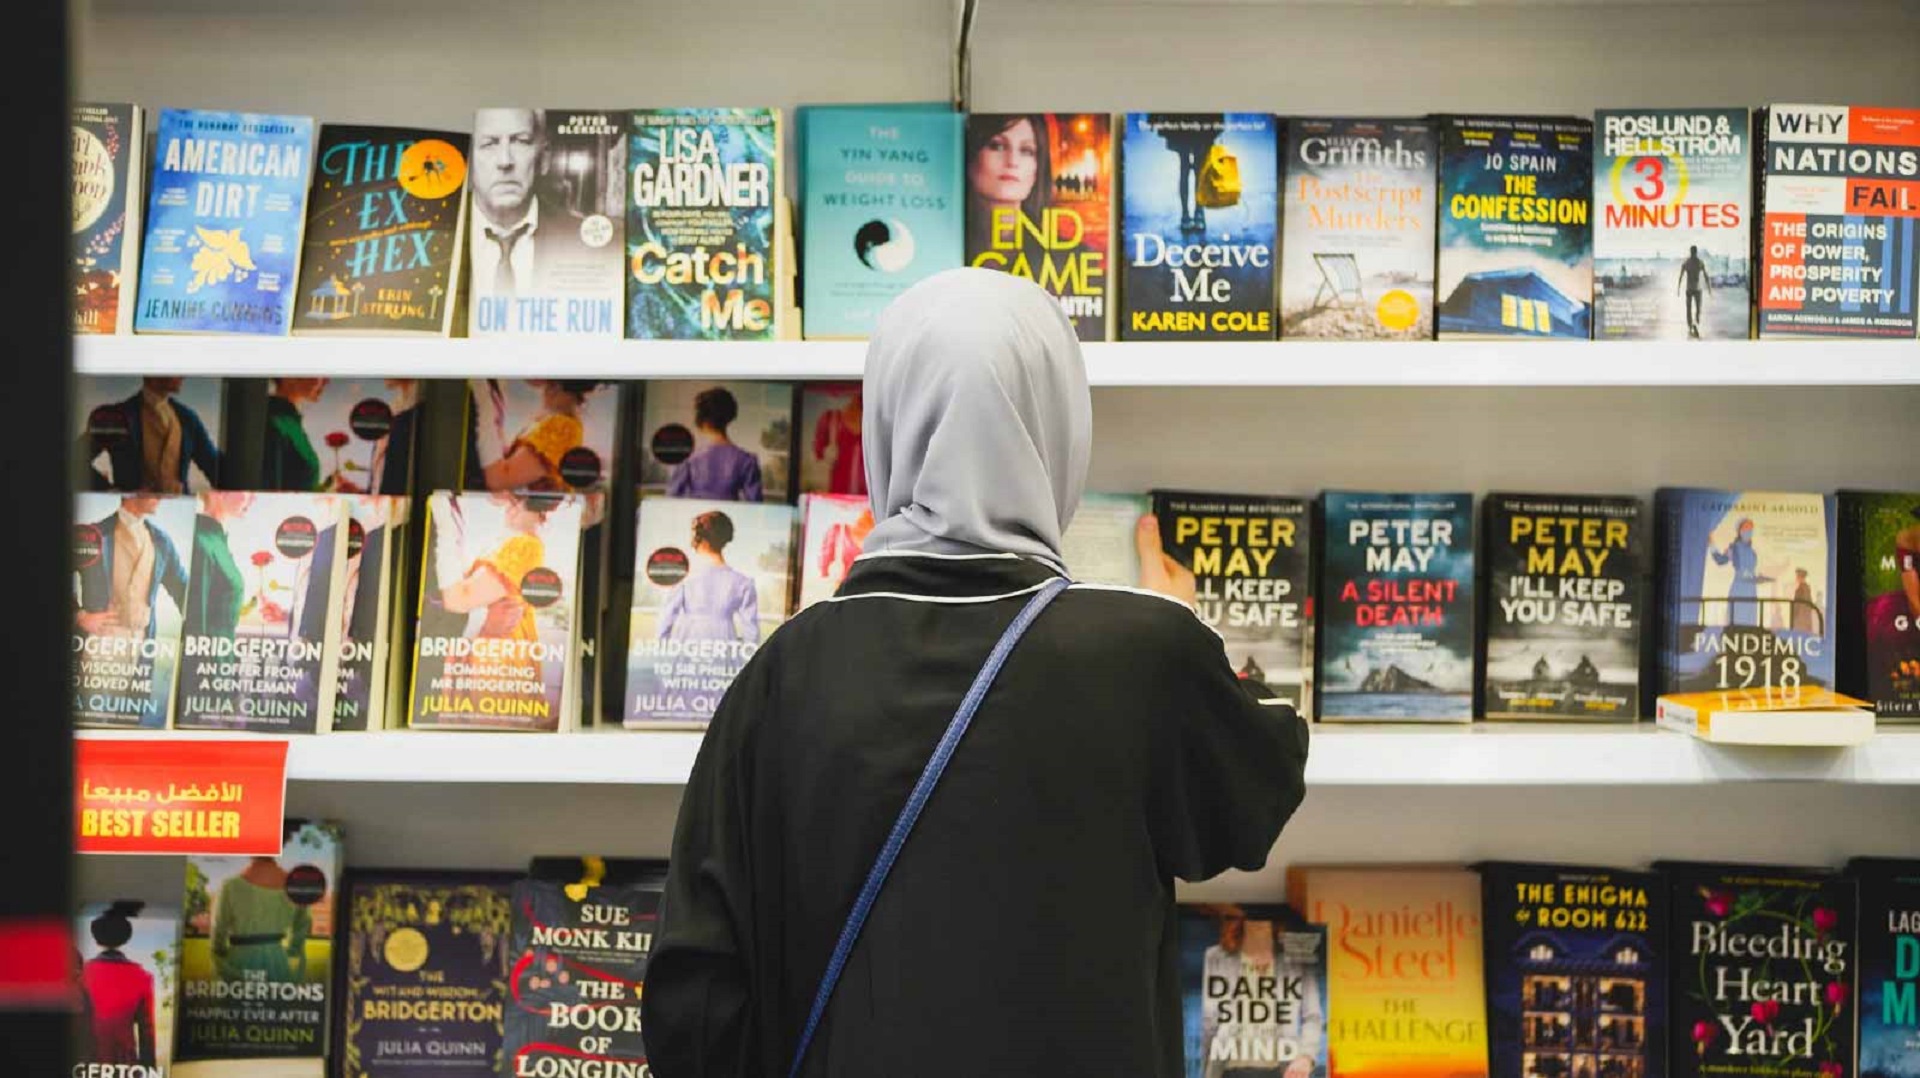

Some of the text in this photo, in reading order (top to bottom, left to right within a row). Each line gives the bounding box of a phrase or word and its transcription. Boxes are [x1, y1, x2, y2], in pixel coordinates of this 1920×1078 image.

[569, 115, 607, 126] PETER
[1604, 115, 1731, 136] ROSLUND &
[1776, 113, 1843, 134] WHY
[869, 126, 900, 140] THE
[660, 128, 720, 164] LISA
[840, 149, 930, 163] YIN YANG
[1300, 137, 1426, 168] Griffiths
[1604, 134, 1741, 157] HELLSTRÖM
[163, 137, 301, 178] AMERICAN
[1484, 153, 1556, 173] JO SPAIN
[1774, 148, 1918, 176] NATIONS
[634, 162, 769, 207] GARDNER
[845, 171, 925, 186] GUIDE TO
[1504, 174, 1537, 195] THE
[1633, 156, 1664, 202] 3
[194, 181, 262, 218] DIRT
[823, 193, 947, 210] WEIGHT LOSS
[1298, 174, 1422, 211] Postscript
[1853, 186, 1916, 211] FAIL
[357, 189, 410, 230] EX
[1309, 204, 1421, 230] Murders
[1451, 193, 1587, 224] CONFESSION
[1605, 203, 1741, 229] MINUTES
[992, 208, 1084, 250] END
[1772, 222, 1887, 240] THE ORIGINS
[346, 230, 435, 278] HEX
[1132, 232, 1269, 268] Deceive
[1770, 243, 1870, 263] OF POWER,
[631, 243, 764, 285] Catch
[1769, 265, 1883, 283] PROSPERITY
[378, 288, 413, 302] ERIN
[1170, 268, 1231, 303] Me
[1768, 286, 1895, 305] AND POVERTY
[361, 302, 426, 320] STERLING
[478, 296, 612, 333] ON THE RUN
[701, 289, 771, 332] Me
[1132, 311, 1270, 331] KAREN COLE
[1176, 517, 1296, 547] PETER
[1349, 519, 1453, 546] PETER
[1511, 516, 1629, 548] PETER
[1193, 547, 1276, 577] MAY
[1366, 547, 1435, 572] MAY
[1528, 546, 1609, 577] MAY
[1225, 578, 1291, 600] KEEP
[1341, 580, 1458, 602] A SILENT
[1510, 576, 1625, 602] I'LL KEEP
[1228, 602, 1298, 627] SAFE
[1356, 604, 1442, 627] DEATH
[1500, 598, 1632, 628] YOU SAFE
[184, 636, 322, 662] BRIDGERTON
[420, 637, 564, 662] BRIDGERTON
[1694, 632, 1824, 657] PANDEMIC
[80, 661, 152, 676] VISCOUNT
[196, 663, 303, 681] AN OFFER FROM
[444, 663, 536, 679] ROMANCING
[654, 663, 696, 676] TO SIR
[1716, 655, 1801, 688] 1918
[83, 677, 153, 693] LOVED ME
[199, 679, 297, 694] A GENTLEMAN
[430, 678, 546, 694] MR BRIDGERTON
[662, 678, 698, 690] WITH
[89, 694, 158, 715] QUINN
[184, 696, 308, 718] JULIA QUINN
[420, 695, 474, 717] JULIA
[479, 697, 549, 718] QUINN
[634, 694, 686, 714] JULIA
[156, 781, 243, 804] الأفضل
[82, 809, 240, 838] BEST SELLER
[1516, 883, 1649, 908] THE ENIGMA
[581, 904, 630, 925] SUE
[1314, 901, 1480, 939] Danielle
[1537, 907, 1649, 931] ROOM 622
[532, 926, 610, 949] MONK
[1691, 920, 1848, 975] Bleeding
[1338, 935, 1457, 980] Steel
[244, 969, 268, 981] THE
[419, 970, 445, 983] THE
[1714, 966, 1823, 1006] Heart
[185, 981, 325, 1001] BRIDGERTONS
[576, 980, 625, 1000] THE
[1208, 976, 1302, 1000] DARK
[187, 1006, 319, 1023] HAPPILY EVER AFTER
[363, 1000, 503, 1021] BRIDGERTON
[1217, 1001, 1291, 1024] SIDE
[1383, 998, 1419, 1014] THE
[192, 1024, 314, 1043] JULIA QUINN
[1336, 1019, 1486, 1042] HALLENGE
[1718, 1014, 1815, 1058] Yard
[377, 1040, 486, 1056] JULIA QUINN
[580, 1036, 612, 1054] OF
[1210, 1037, 1299, 1062] MIND
